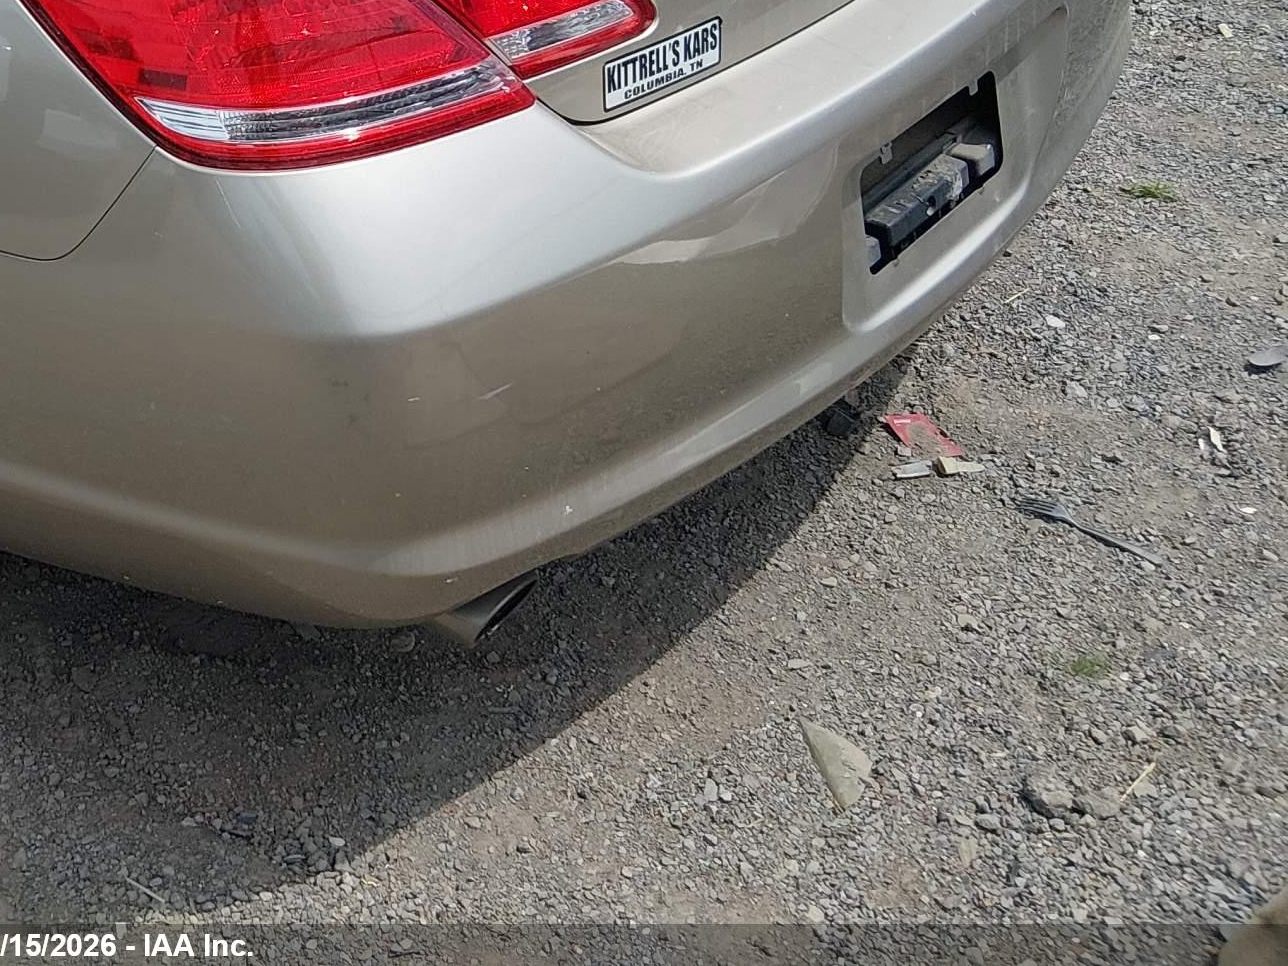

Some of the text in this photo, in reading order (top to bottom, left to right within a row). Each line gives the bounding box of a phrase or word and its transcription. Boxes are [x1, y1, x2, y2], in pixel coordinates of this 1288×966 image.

[607, 23, 718, 94] KITTRELL'S KARS
[689, 59, 704, 72] TN
